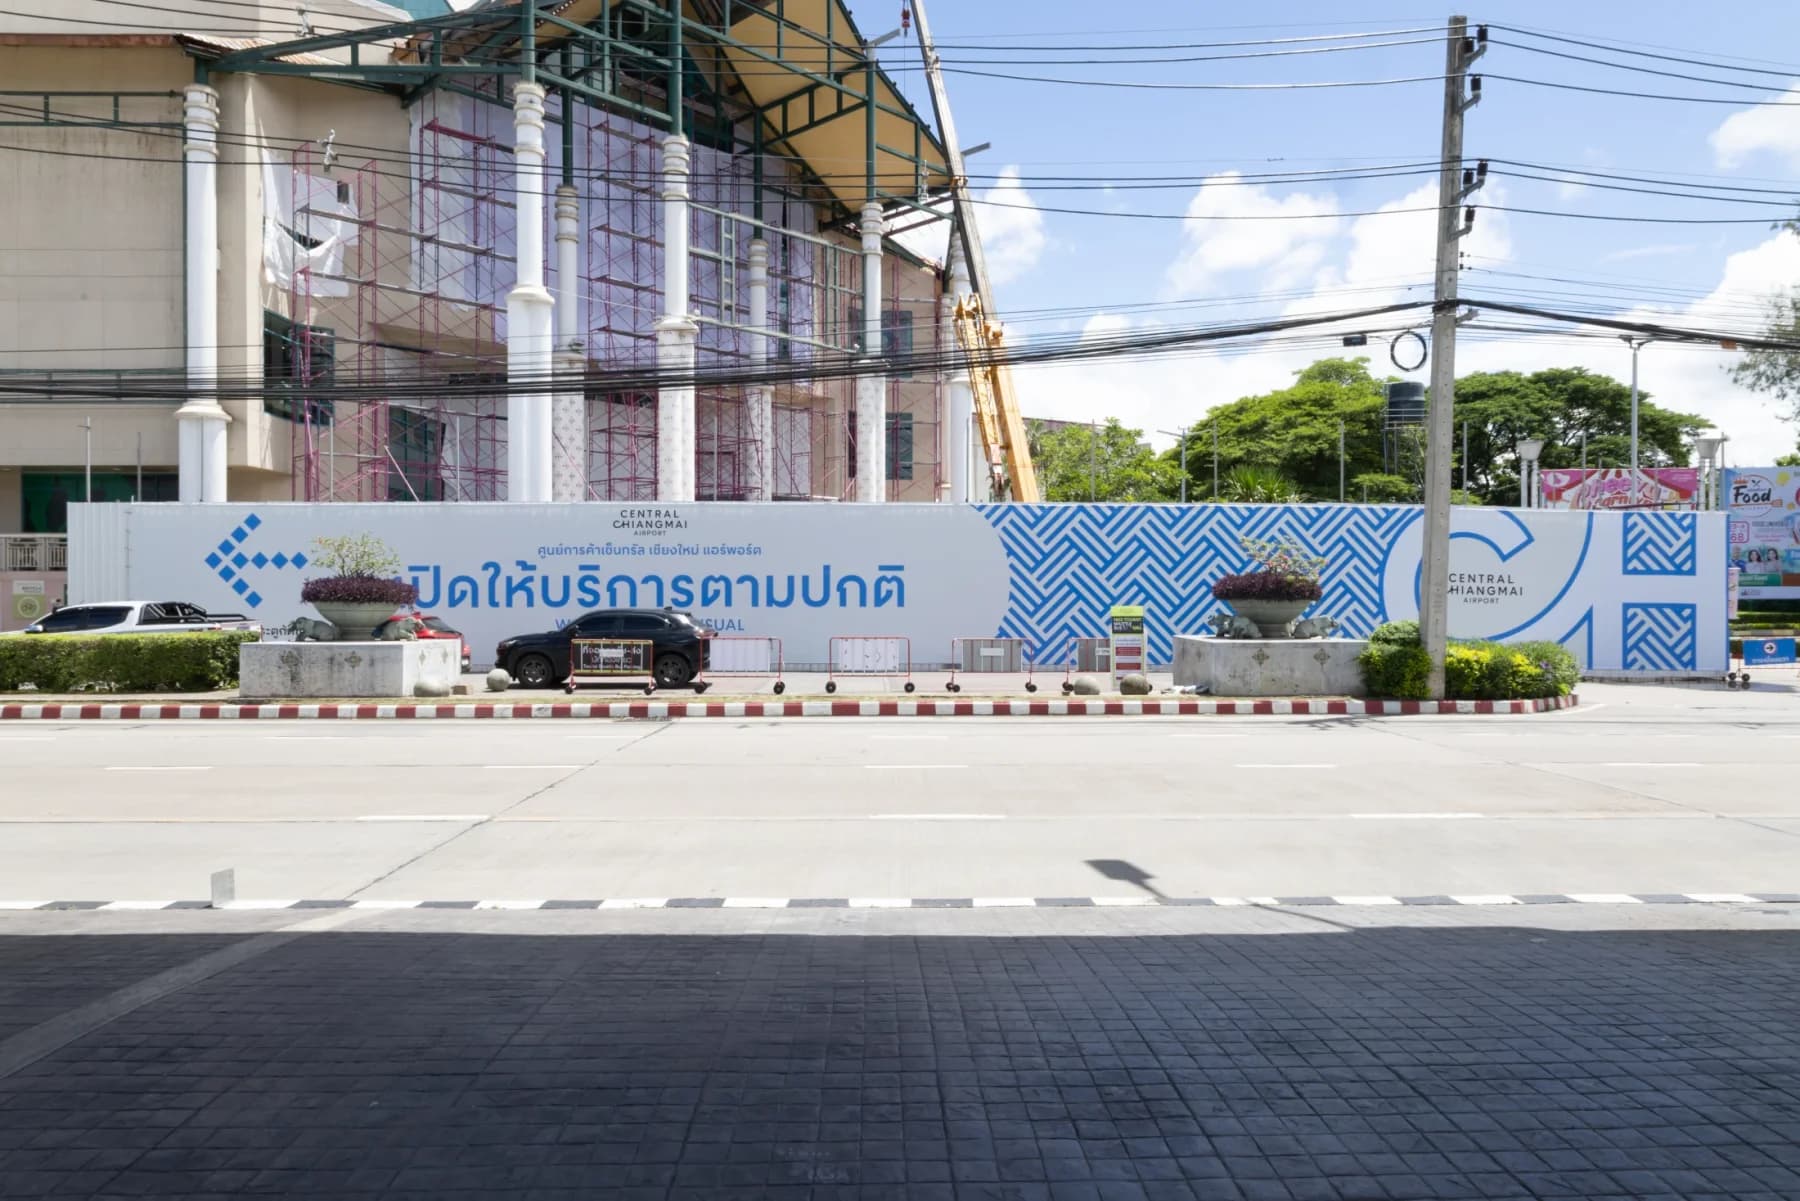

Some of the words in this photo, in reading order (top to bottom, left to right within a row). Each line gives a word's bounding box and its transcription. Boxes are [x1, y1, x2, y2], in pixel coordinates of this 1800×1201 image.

[1733, 485, 1771, 503] Food
[620, 509, 680, 519] CENTRAL
[612, 520, 688, 529] CHIANGMAI
[649, 543, 699, 556] เชียงใหม่
[703, 543, 762, 556] แอร์พอร์ต
[1448, 573, 1515, 584] CENTRAL
[1447, 585, 1523, 596] HIANGMAI
